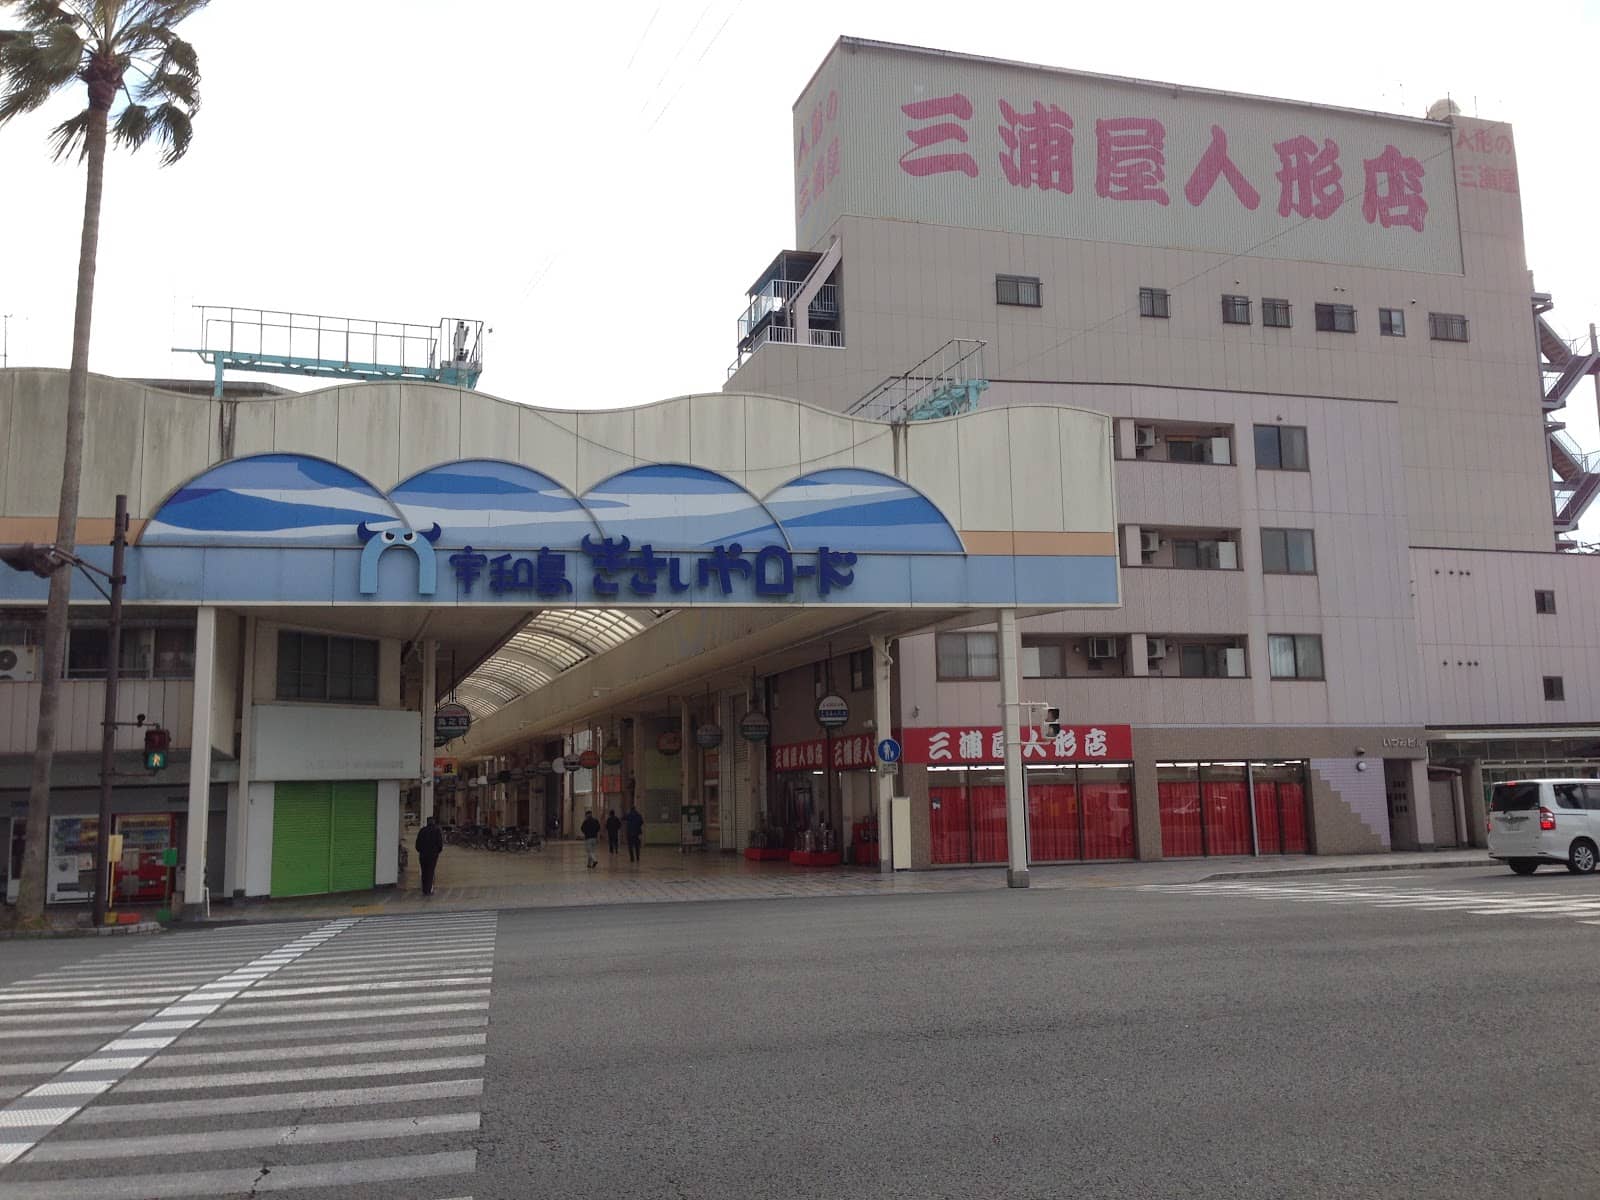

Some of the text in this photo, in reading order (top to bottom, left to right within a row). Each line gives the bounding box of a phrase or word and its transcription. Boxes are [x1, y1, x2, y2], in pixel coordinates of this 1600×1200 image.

[1455, 128, 1513, 154] 人形の
[899, 93, 1428, 233] 三浦屋人形店
[1456, 164, 1516, 192] 三浦屋
[449, 533, 858, 595] 宇和島 きさいやロード
[834, 736, 877, 767] 三浦屋人
[928, 728, 1109, 760] 三浦屋人形店
